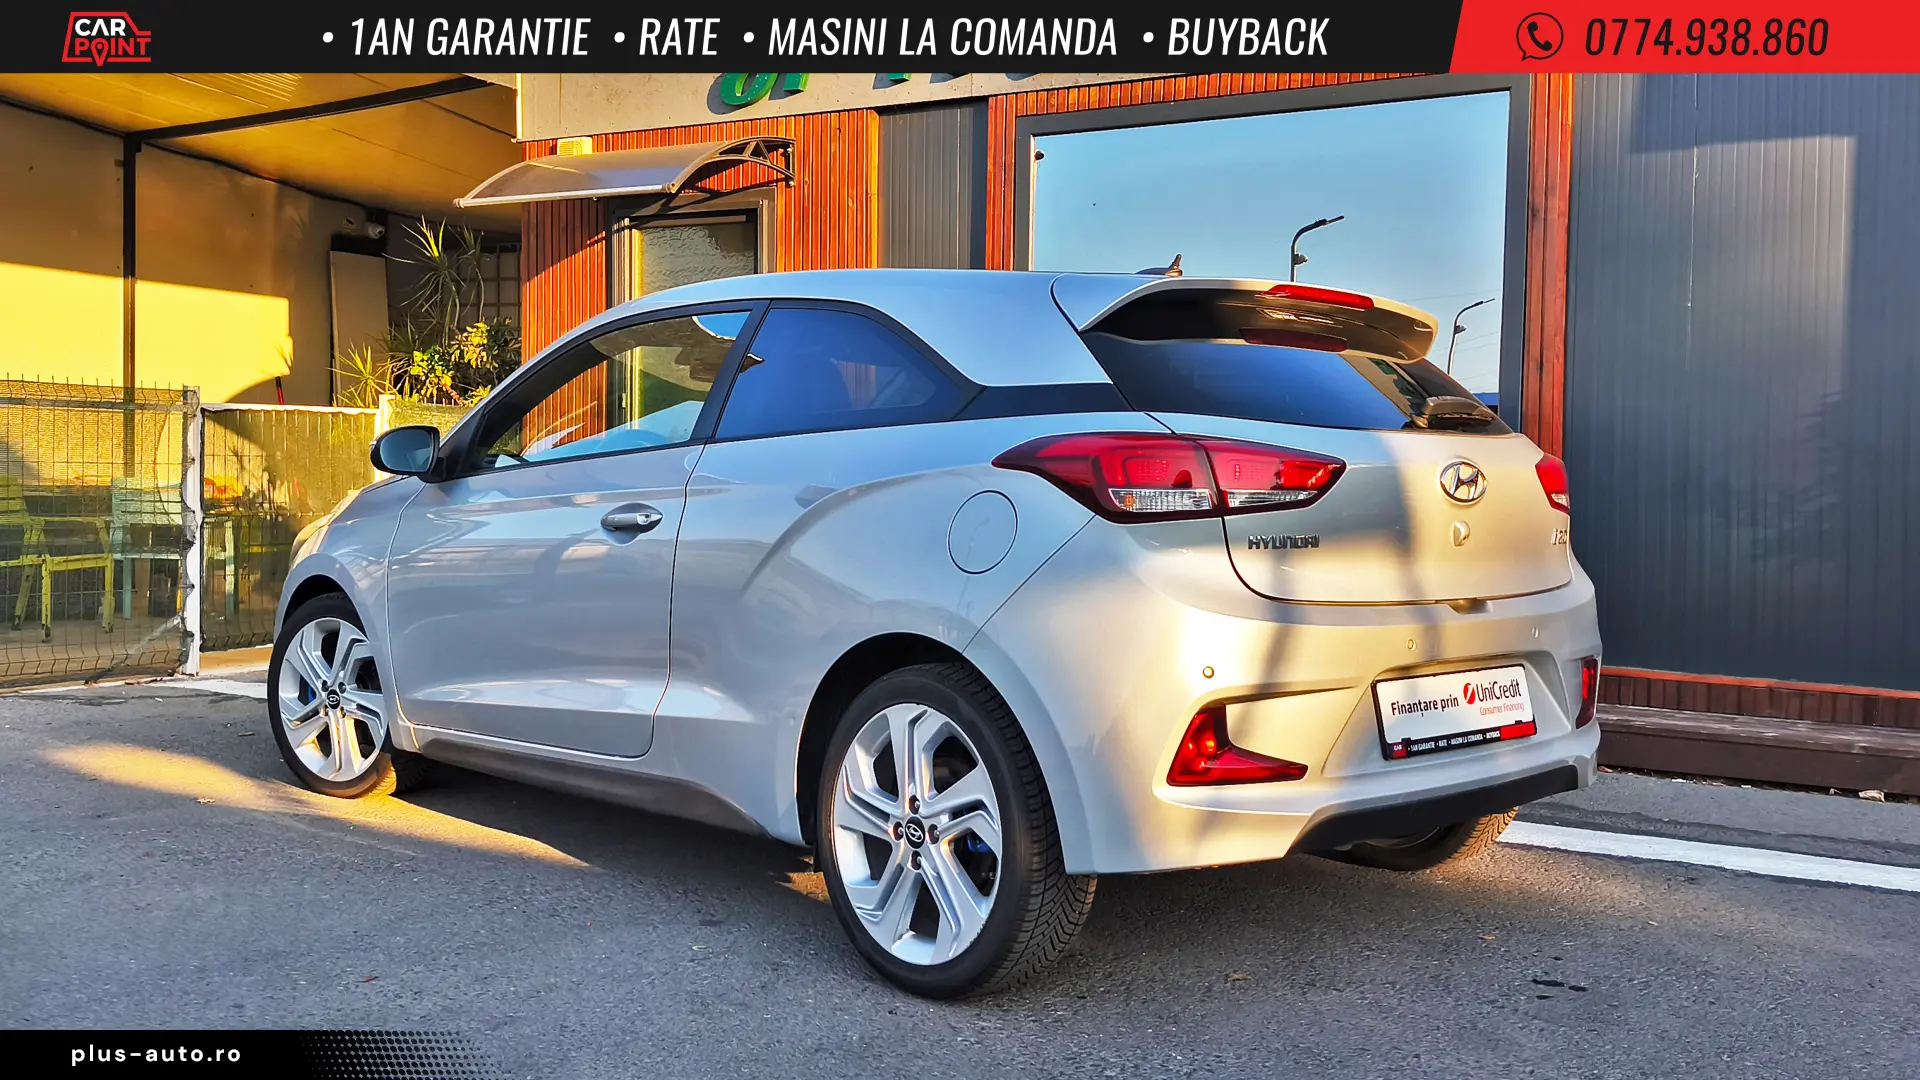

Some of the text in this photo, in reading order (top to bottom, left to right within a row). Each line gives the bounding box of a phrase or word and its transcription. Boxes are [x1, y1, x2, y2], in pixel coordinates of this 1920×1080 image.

[1248, 534, 1319, 550] HYUNDAI
[1476, 679, 1521, 702] UniCredit
[1391, 693, 1459, 718] Finanțare prin
